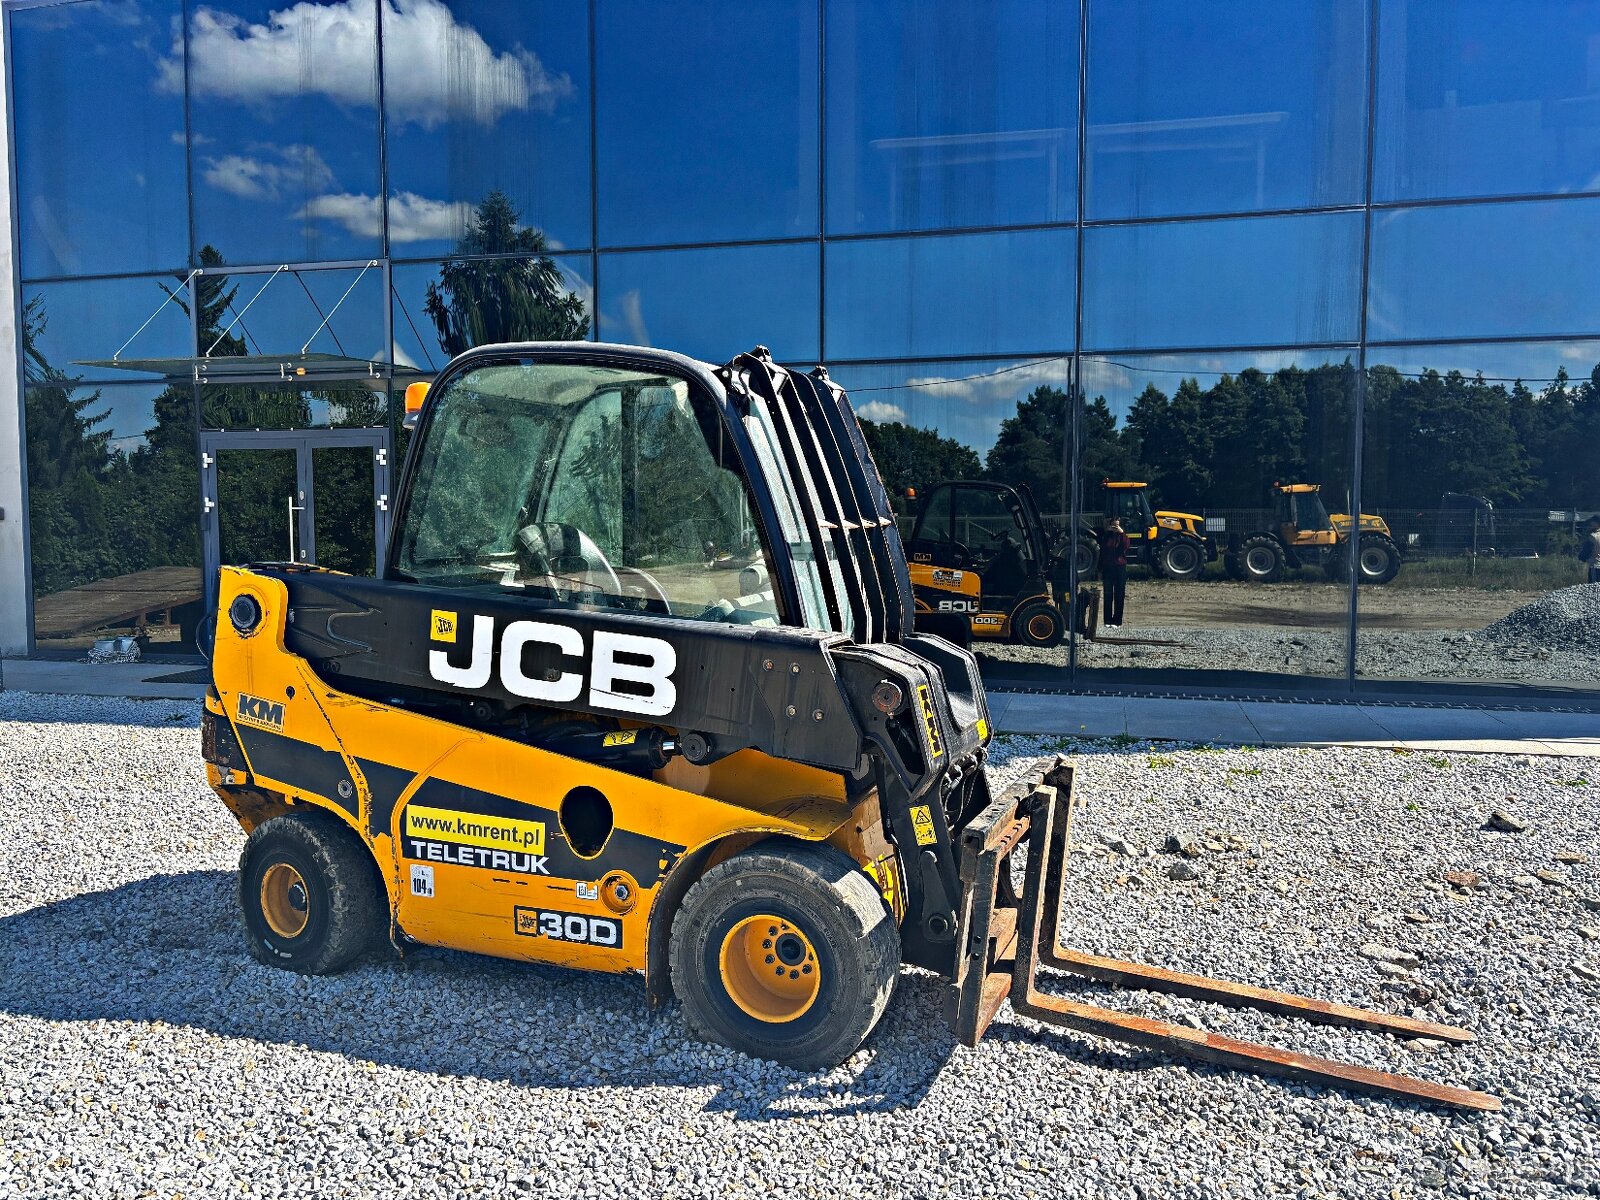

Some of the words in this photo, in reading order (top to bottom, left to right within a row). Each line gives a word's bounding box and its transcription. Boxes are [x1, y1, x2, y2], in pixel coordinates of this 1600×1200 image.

[437, 618, 453, 633] JCB
[429, 614, 677, 716] JCB
[239, 694, 283, 725] KM
[920, 689, 941, 754] KM
[411, 814, 540, 847] www.kmrent.pl
[411, 840, 551, 875] TELETRUK
[413, 878, 427, 894] 104
[539, 912, 617, 945] 30D
